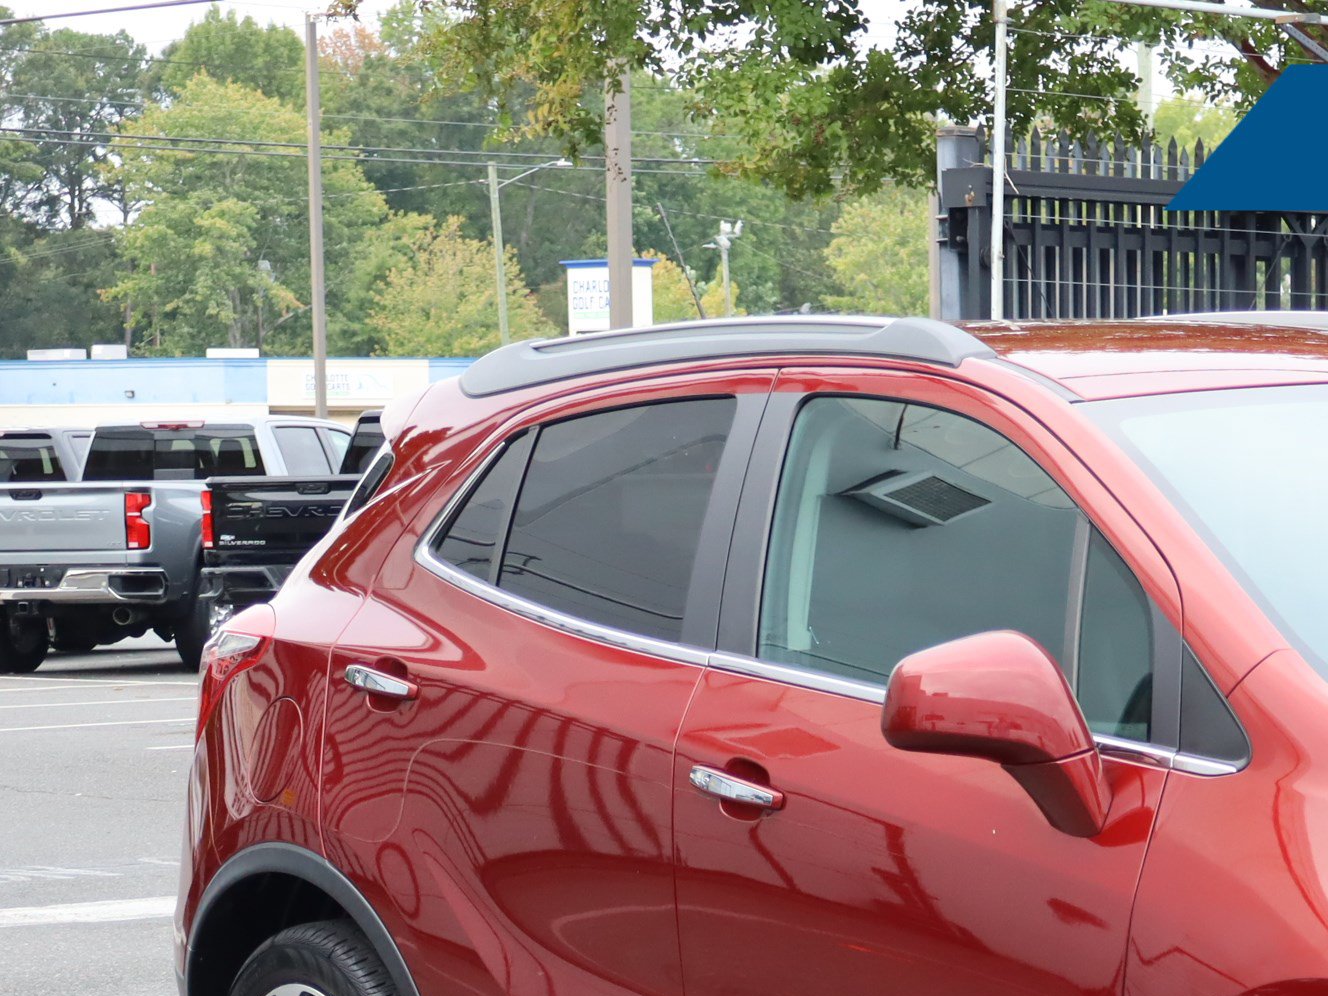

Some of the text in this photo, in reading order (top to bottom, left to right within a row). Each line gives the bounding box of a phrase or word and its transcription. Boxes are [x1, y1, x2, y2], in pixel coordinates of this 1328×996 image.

[573, 280, 610, 293] CHARLO
[305, 374, 349, 382] CHLOTTE
[0, 511, 111, 522] VROLET
[226, 504, 342, 518] CHEVRO
